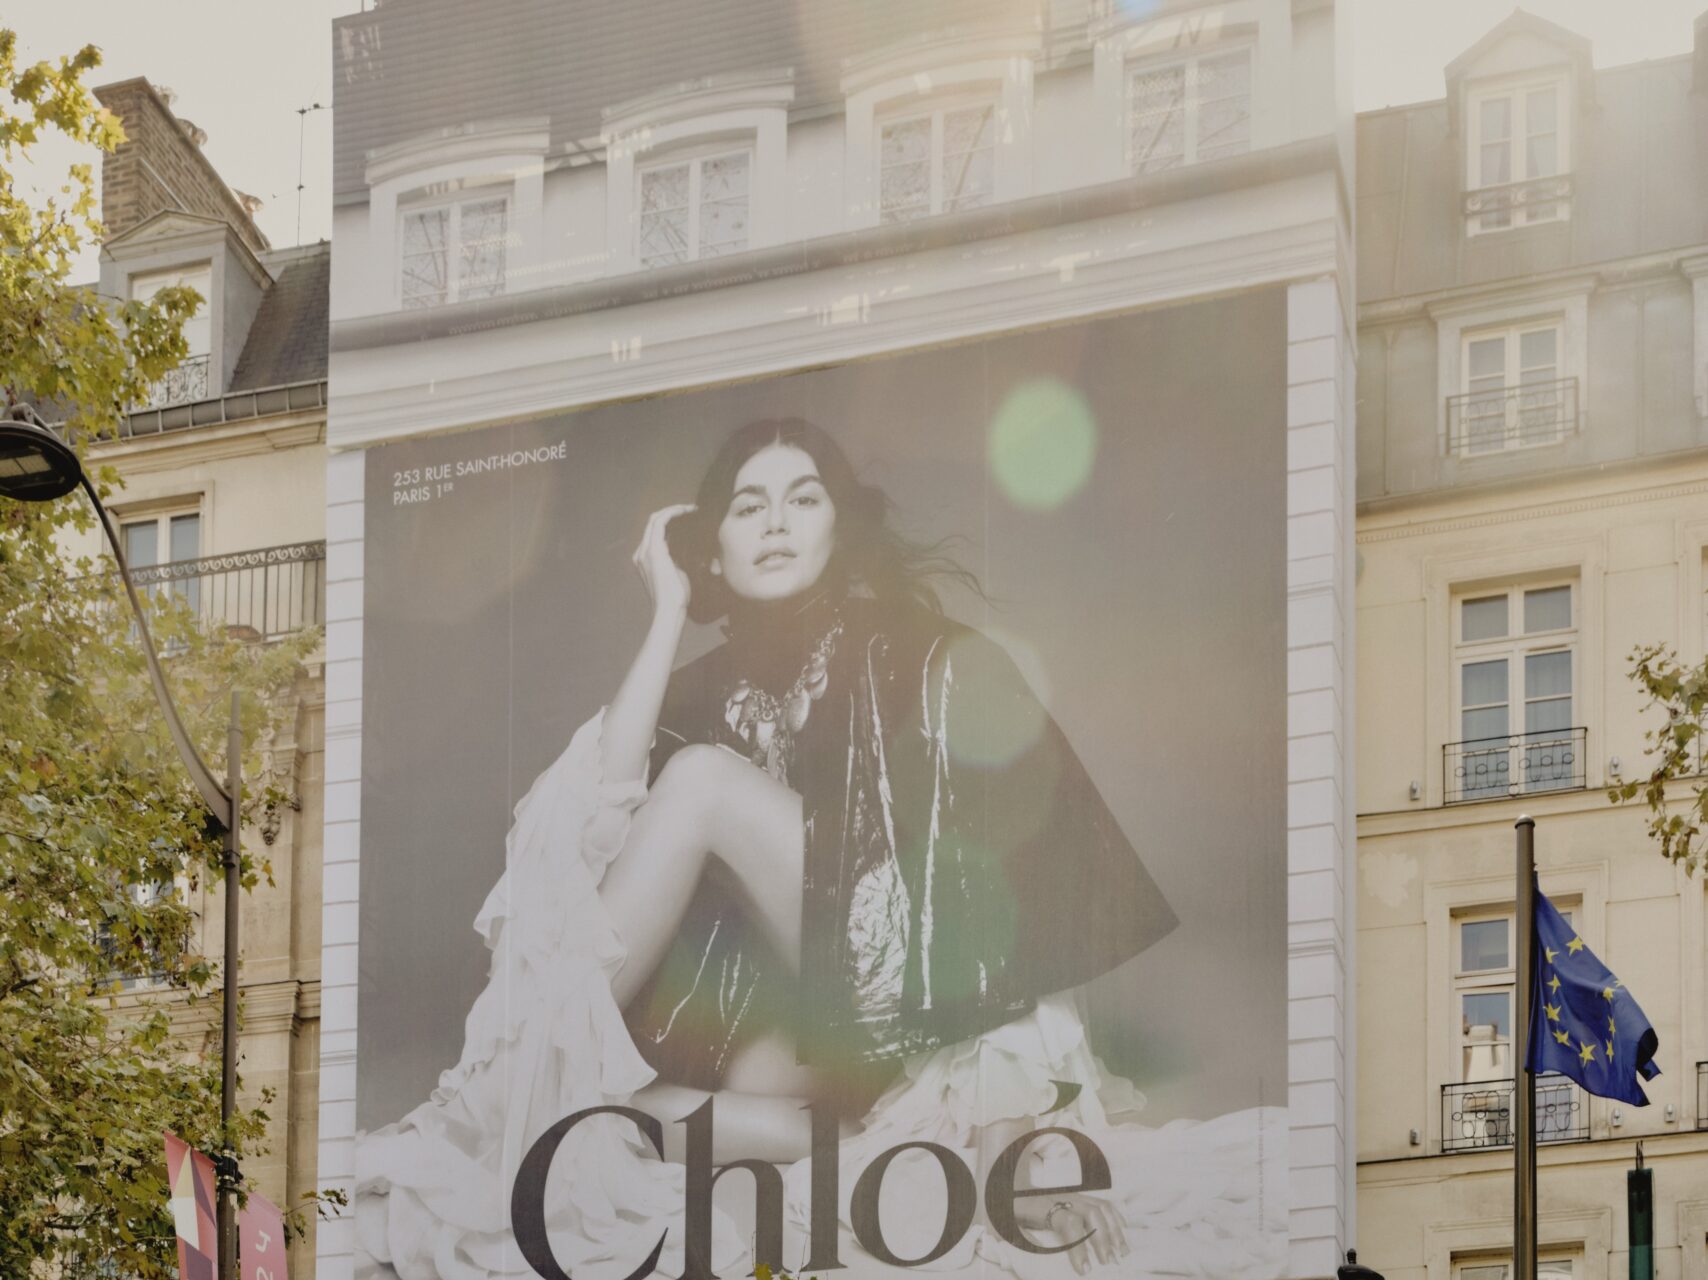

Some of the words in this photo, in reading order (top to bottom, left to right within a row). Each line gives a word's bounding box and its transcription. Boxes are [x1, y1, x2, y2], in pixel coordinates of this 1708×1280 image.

[393, 469, 420, 487] 253
[425, 463, 451, 482] RUE
[456, 440, 567, 477] SAINT-HONORÉ
[393, 486, 430, 506] PARIS
